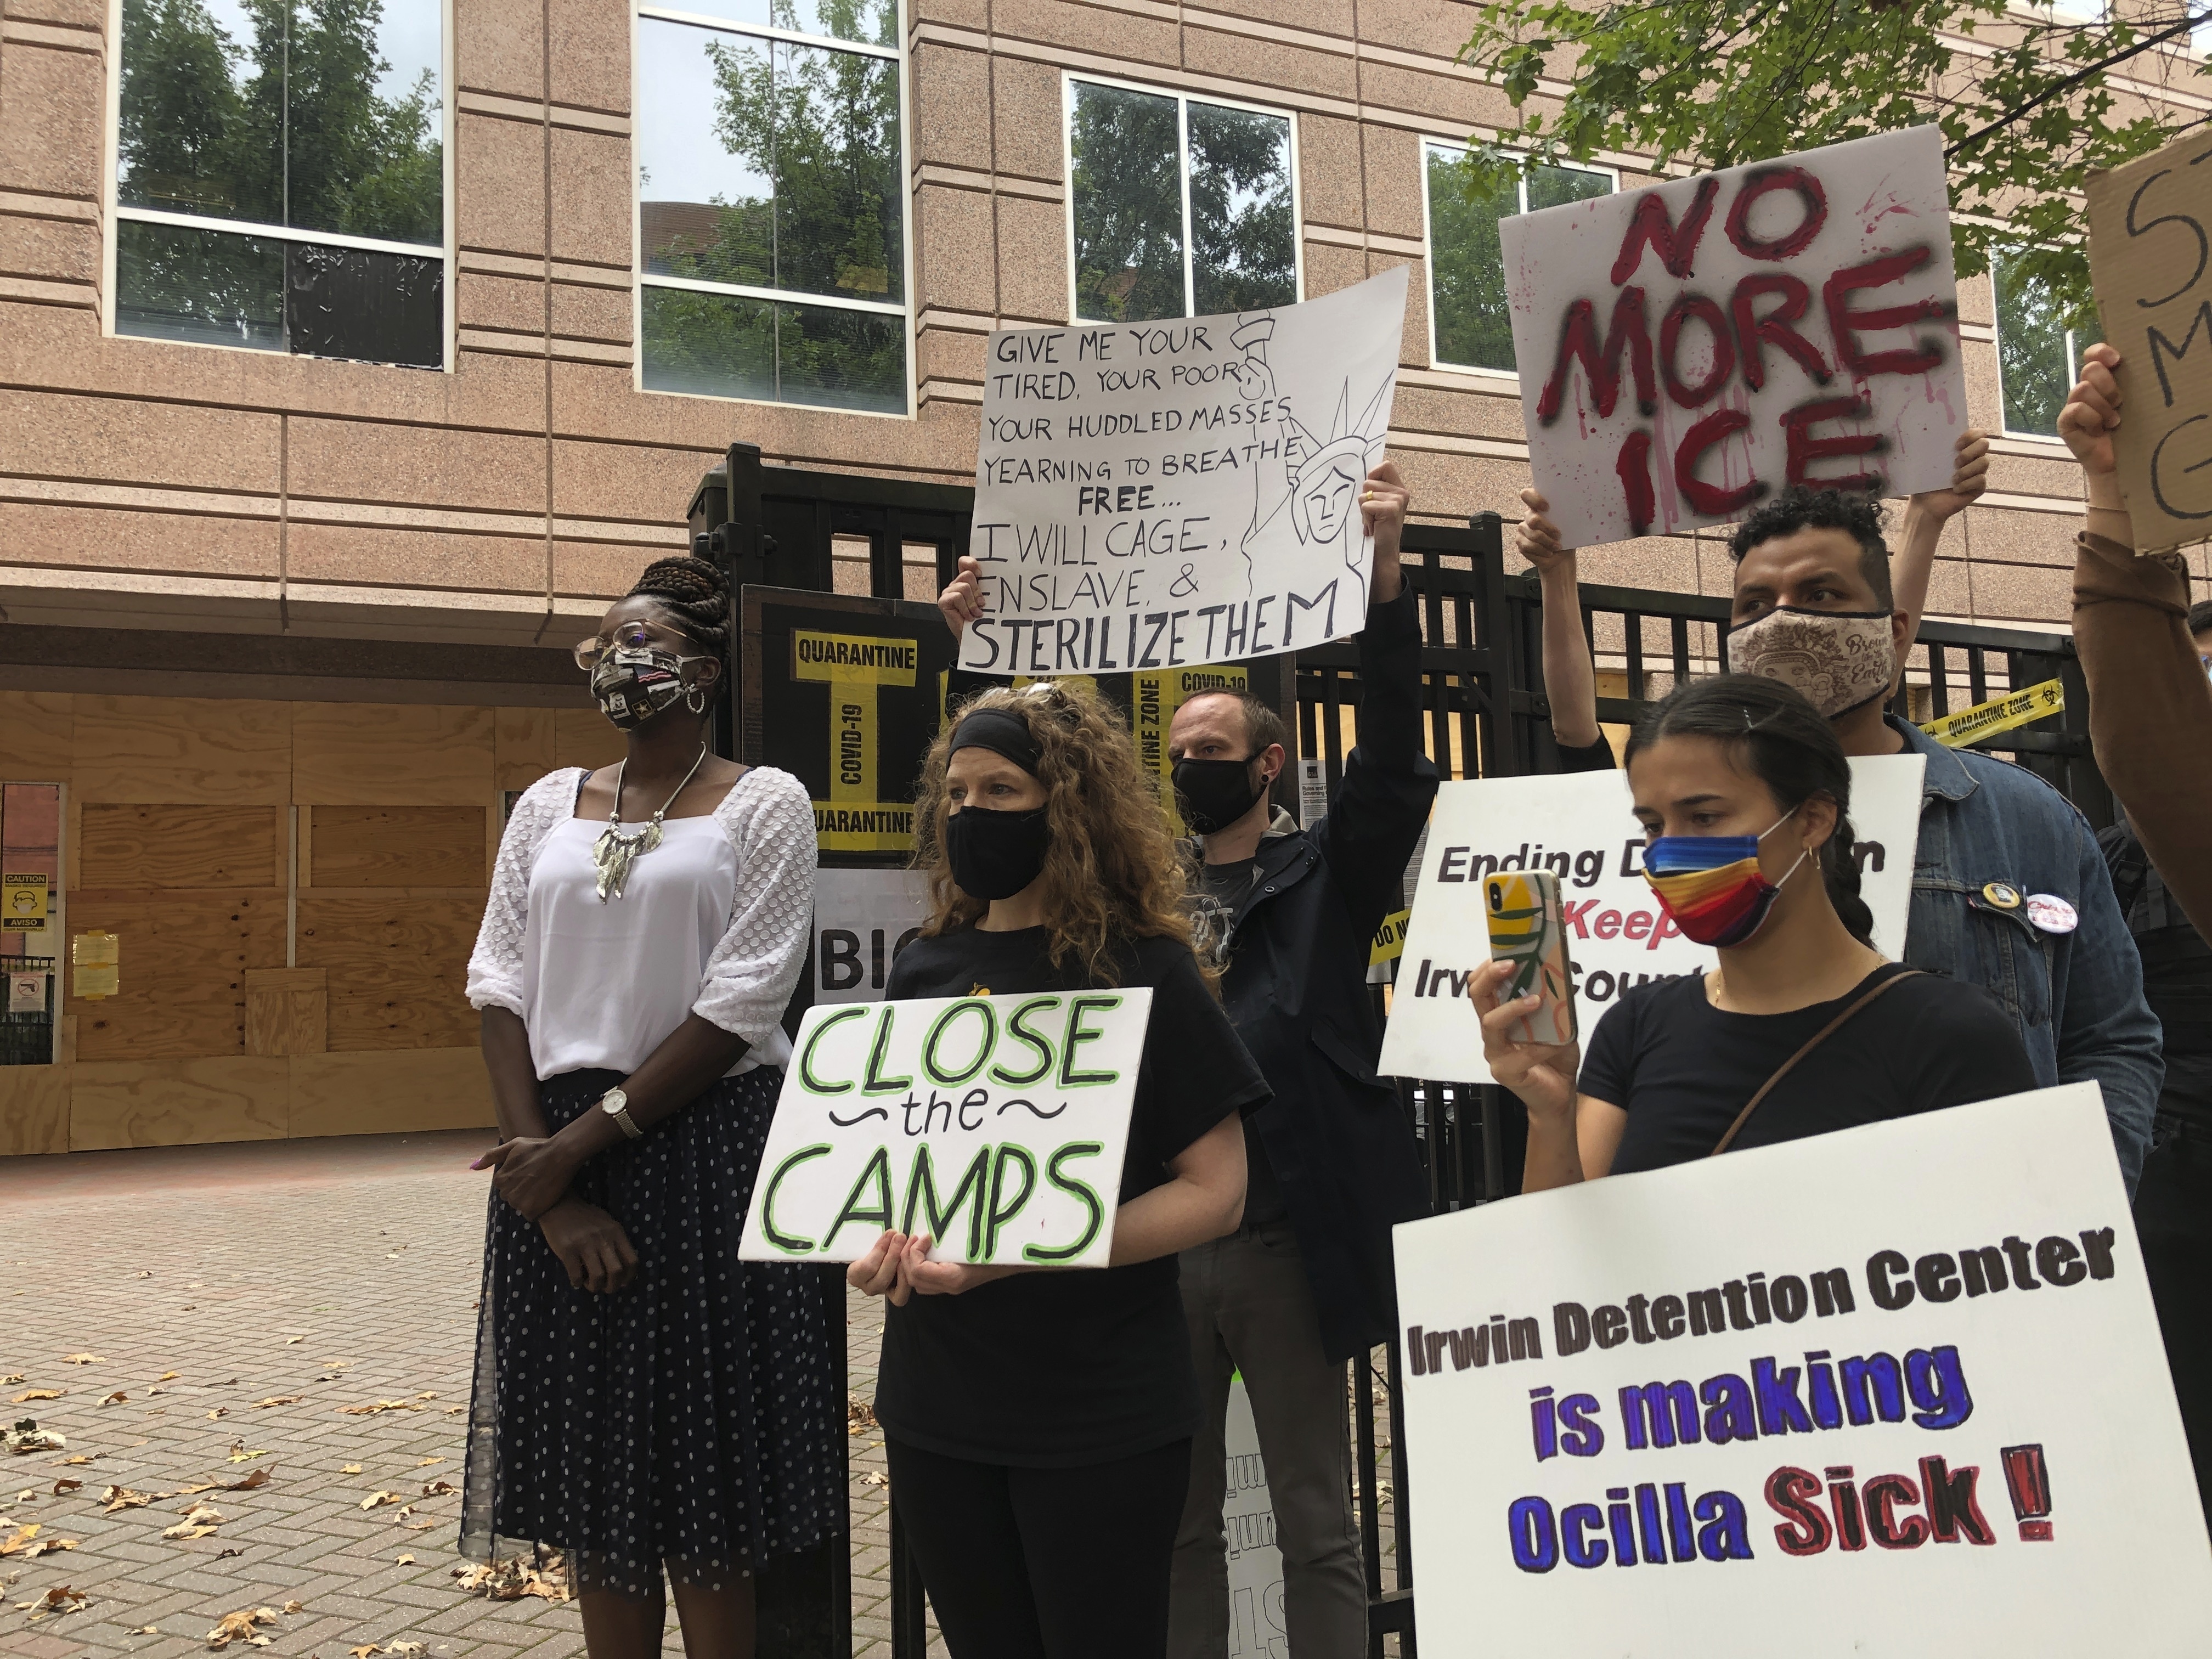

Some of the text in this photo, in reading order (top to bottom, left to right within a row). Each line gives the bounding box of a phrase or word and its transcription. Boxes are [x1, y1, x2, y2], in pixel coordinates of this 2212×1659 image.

[1611, 165, 1829, 286] NO
[997, 326, 1214, 365] GIVE ME YOUR
[1536, 245, 1953, 428] MORE
[1098, 369, 1161, 393] YOUR
[989, 396, 1292, 442] YOUR HUDDLED MASSES
[984, 436, 1303, 487] YEARNING TO BREATHE
[1616, 390, 1887, 538] ICE
[977, 523, 1011, 562] I
[1016, 523, 1098, 566] WILL
[1169, 563, 1199, 597] &
[965, 578, 1339, 672] STERILIZE THEM
[799, 639, 915, 669] QUARANTINE
[1141, 679, 1160, 725] ZONE
[1948, 694, 2034, 737] QUARANTINE ZONE
[840, 704, 862, 785] COVID-19
[814, 809, 913, 834] UARANTINE
[1437, 843, 1605, 888] Ending
[821, 927, 925, 991] BI
[1374, 924, 1394, 948] DO
[799, 995, 1121, 1097] CLOSE
[900, 1088, 989, 1136] the
[759, 1141, 1105, 1265] CAMPS
[1406, 1226, 2117, 1376] Irwin Detention Center
[1529, 1345, 1974, 1462] is making
[1508, 1483, 1754, 1573] Ocilla
